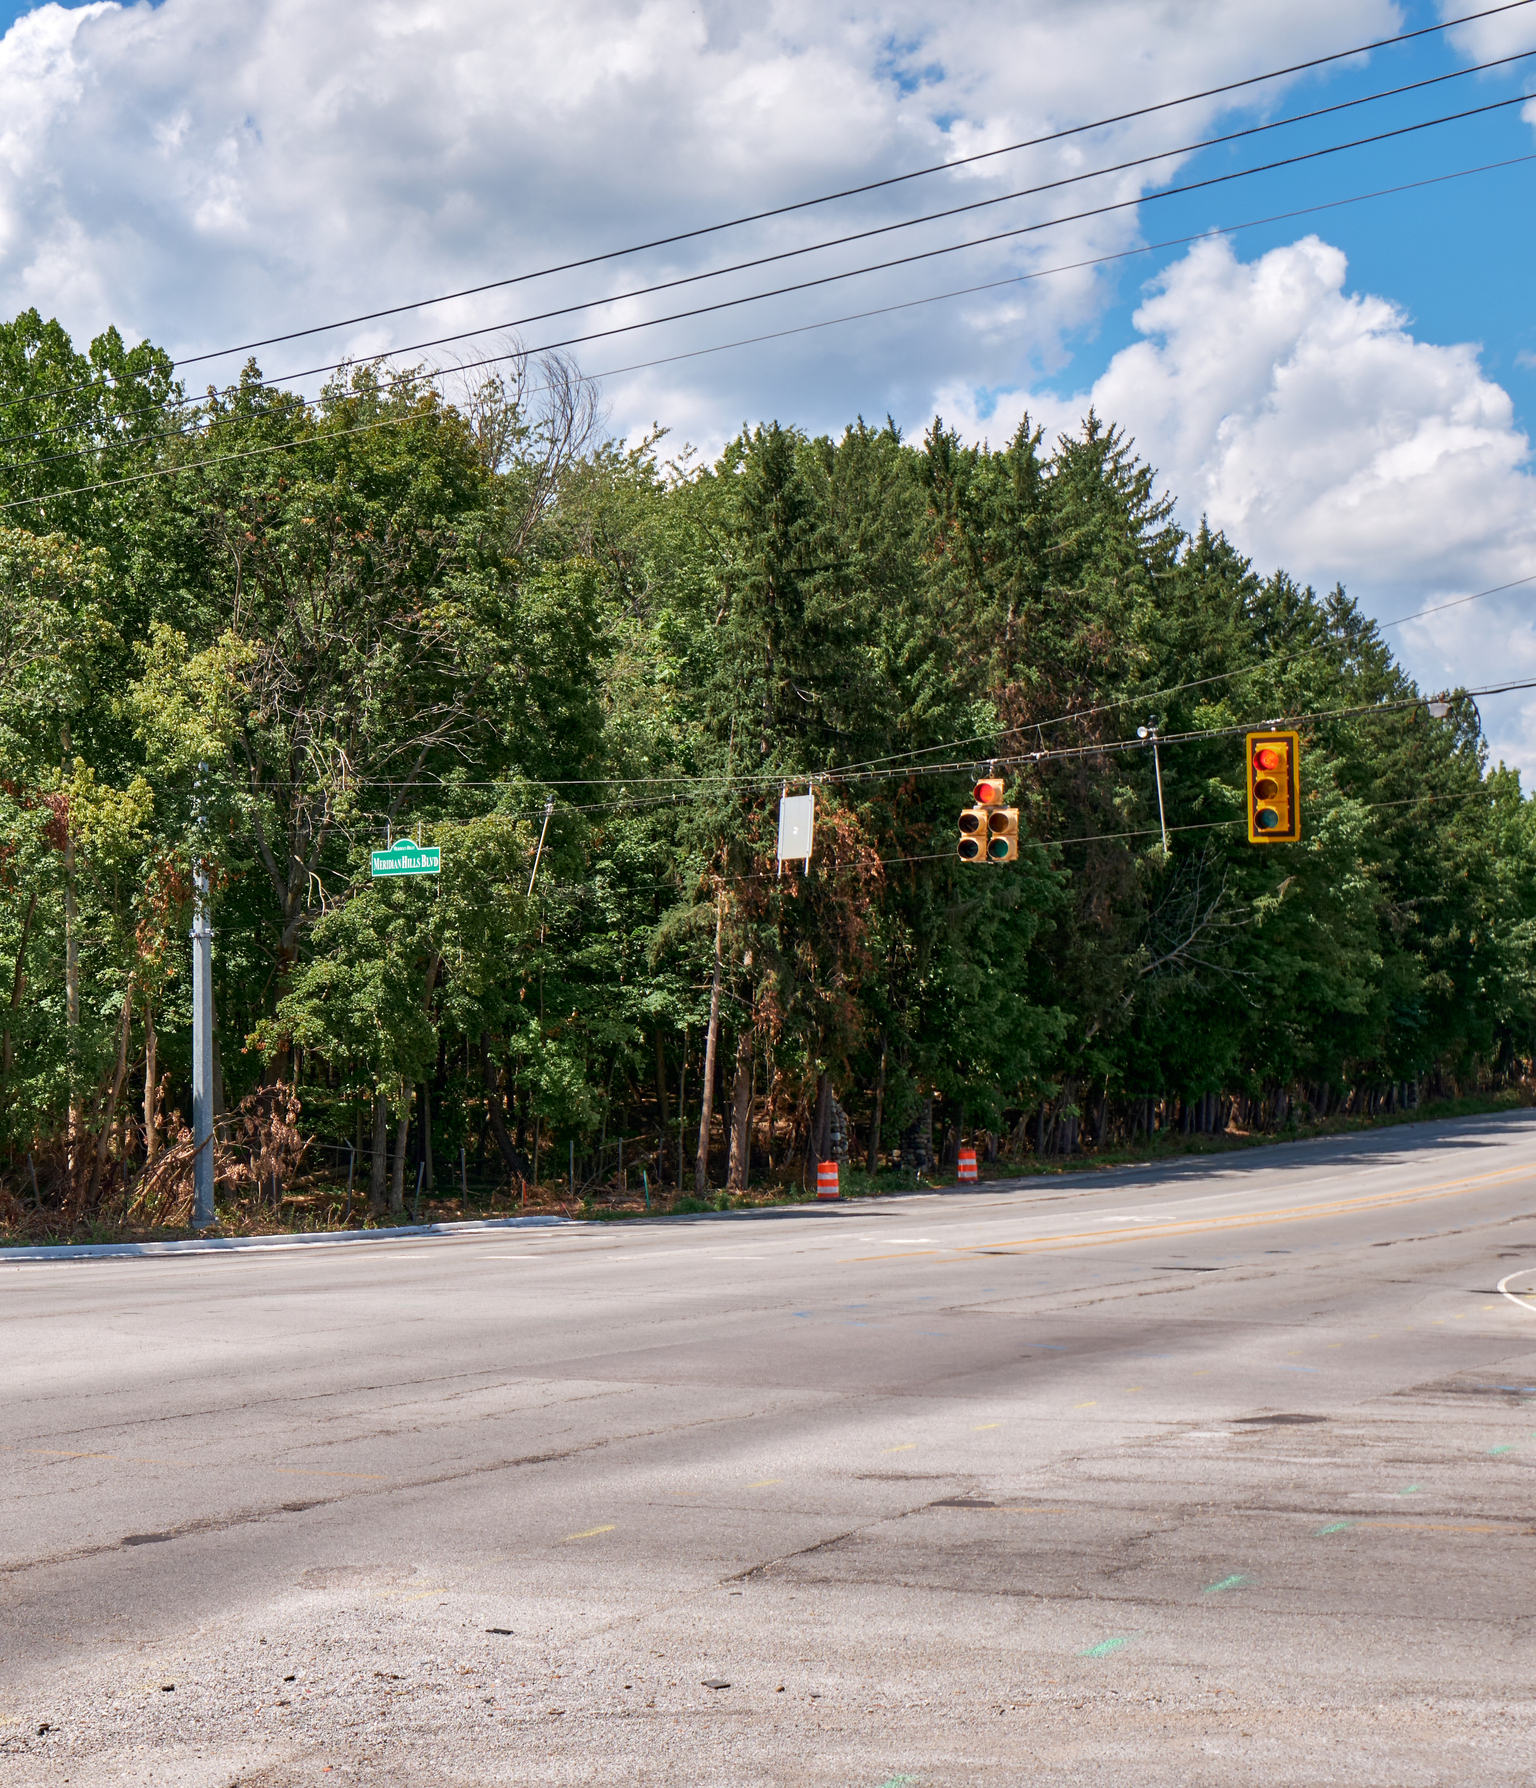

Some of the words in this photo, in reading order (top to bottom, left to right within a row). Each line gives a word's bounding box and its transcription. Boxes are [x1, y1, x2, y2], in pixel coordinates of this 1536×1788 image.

[373, 857, 402, 871] MERIDIAN
[402, 855, 421, 869] HILLS
[421, 854, 439, 868] BLVD
